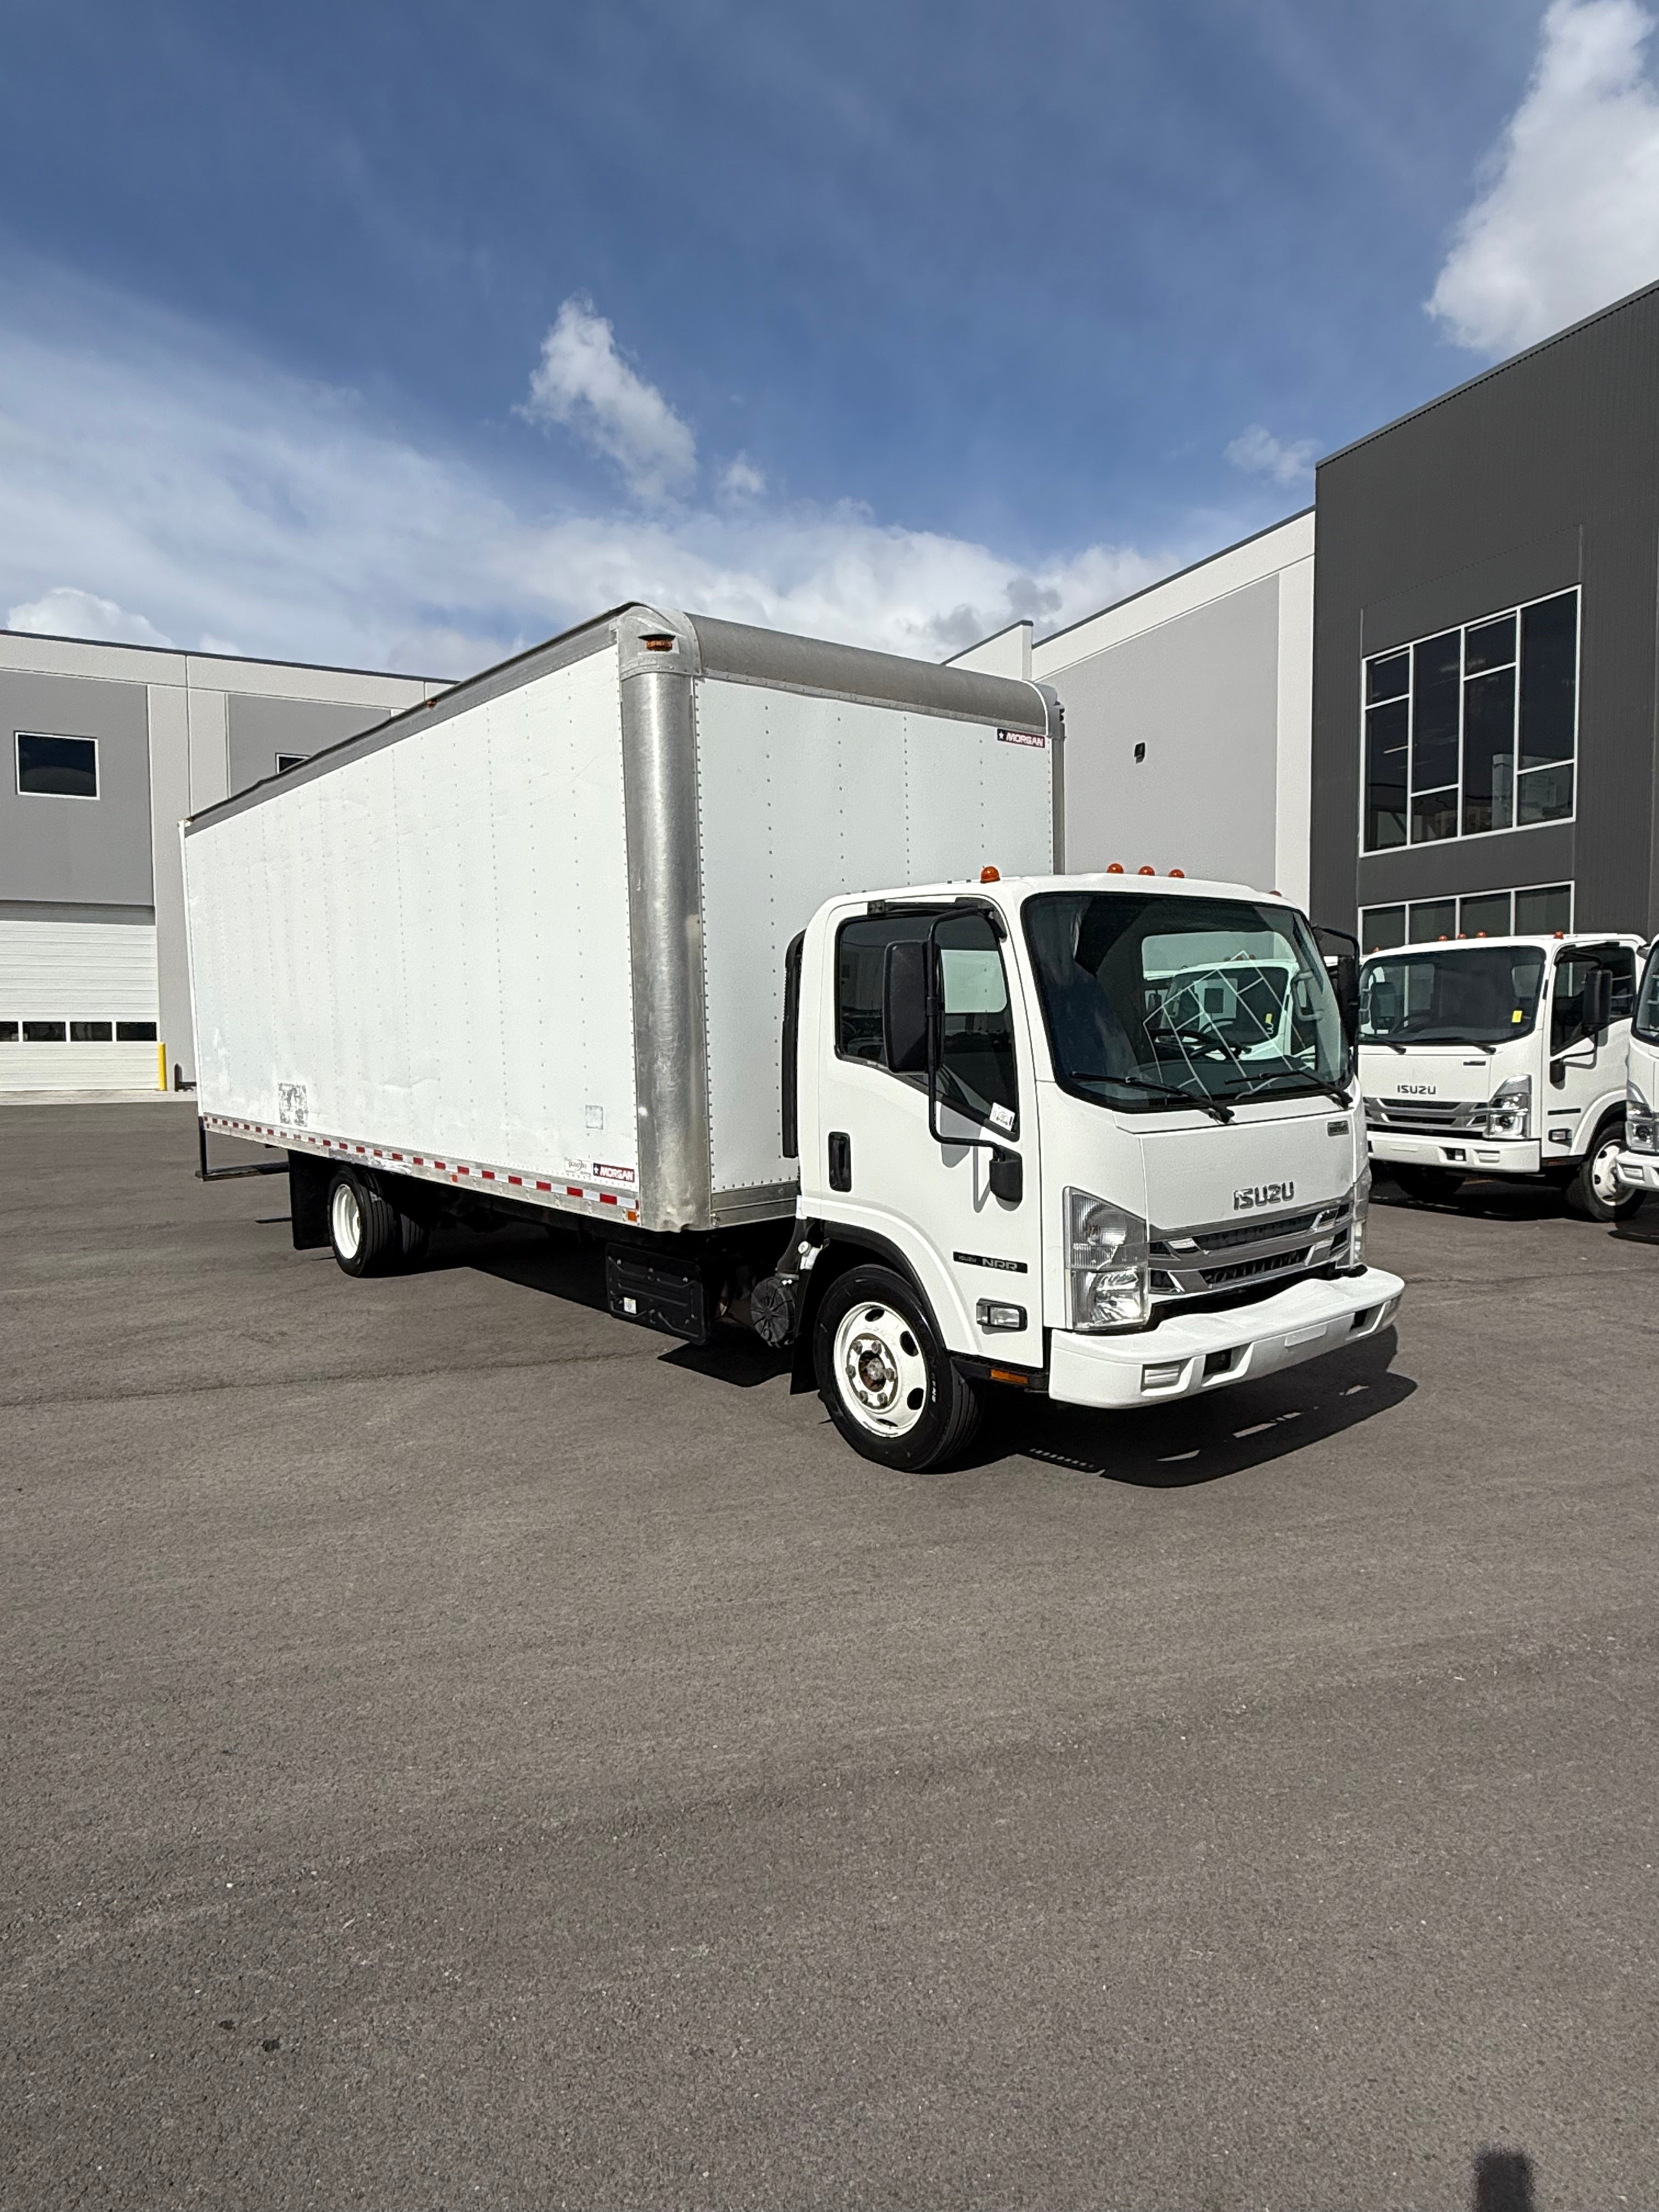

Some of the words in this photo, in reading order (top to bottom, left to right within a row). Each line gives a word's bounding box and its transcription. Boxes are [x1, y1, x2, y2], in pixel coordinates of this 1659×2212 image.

[1006, 732, 1043, 747] MORGAN
[1397, 1085, 1436, 1095] ISUZU
[600, 1166, 634, 1181] MORGAN
[1233, 1181, 1295, 1210] ISUZU
[982, 1258, 1018, 1271] NRR
